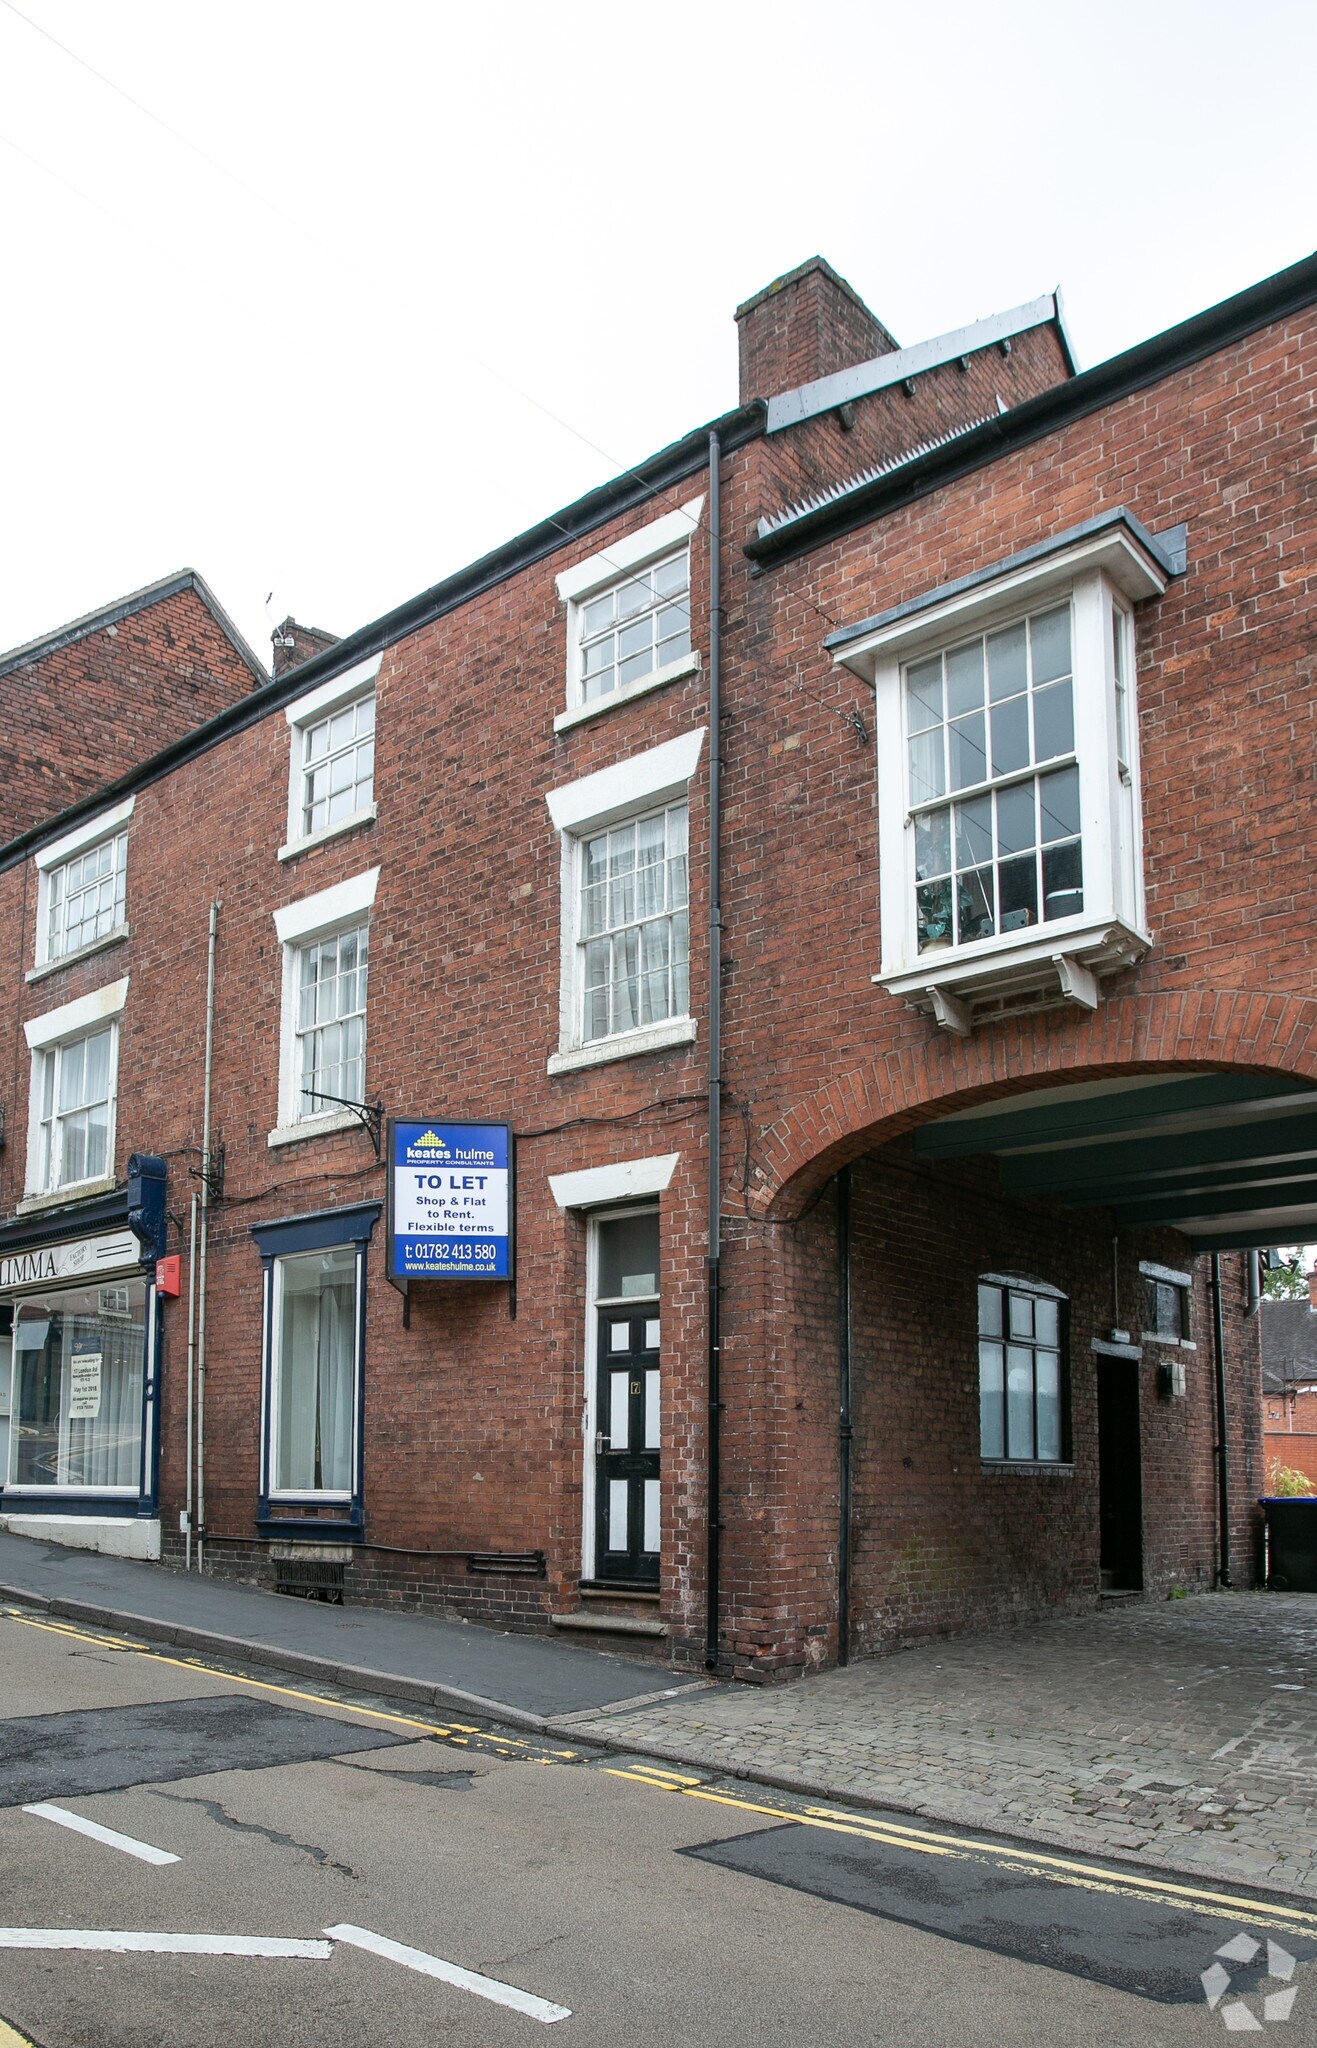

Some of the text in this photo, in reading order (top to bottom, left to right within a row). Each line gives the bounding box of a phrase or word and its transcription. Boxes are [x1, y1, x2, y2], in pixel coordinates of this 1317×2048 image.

[406, 1147, 494, 1160] keates hulme
[414, 1175, 488, 1190] TO LET
[416, 1196, 487, 1207] Shop & Flat
[427, 1210, 475, 1219] to Rent.
[408, 1222, 494, 1232] Flexible terms
[405, 1243, 496, 1260] t: 01782 413 580
[405, 1261, 496, 1271] www.keateshulme.co.uk
[634, 1383, 639, 1393] 7
